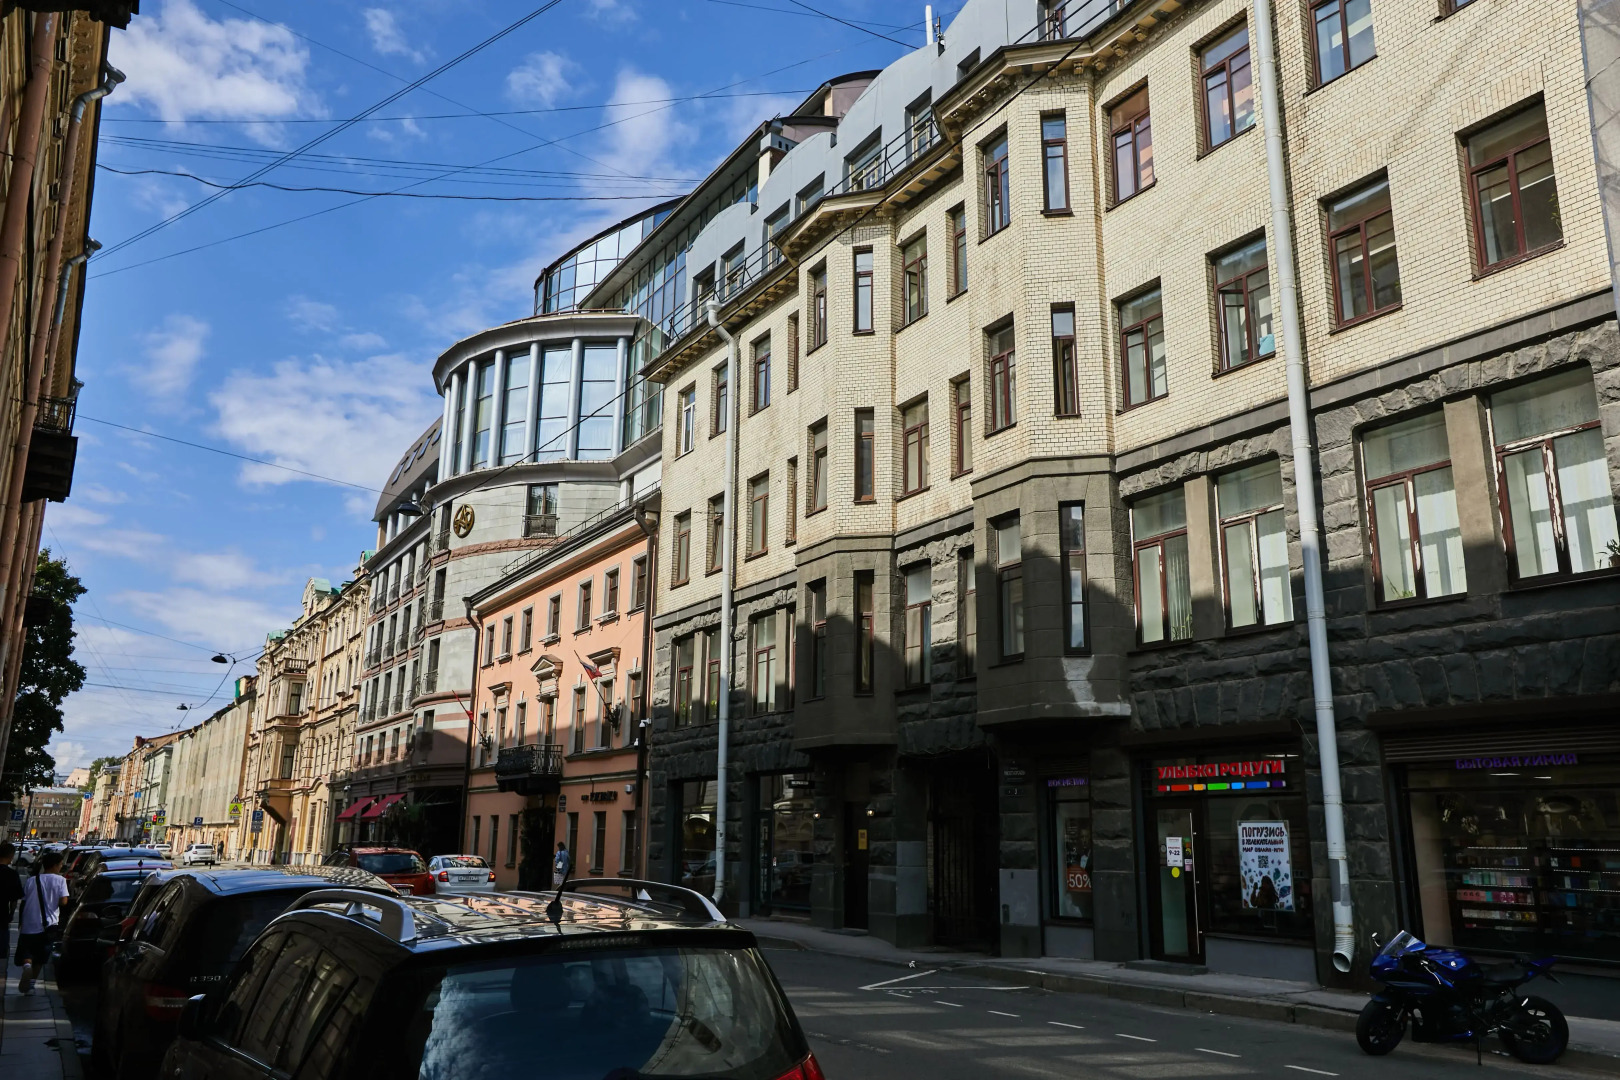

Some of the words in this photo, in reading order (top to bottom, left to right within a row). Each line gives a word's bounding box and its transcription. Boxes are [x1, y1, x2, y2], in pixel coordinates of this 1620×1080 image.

[1455, 756, 1521, 770] БЫТОВАЯ
[1522, 753, 1578, 767] ХИМИЯ
[1242, 826, 1285, 838] ПОГРУЗИСЬ
